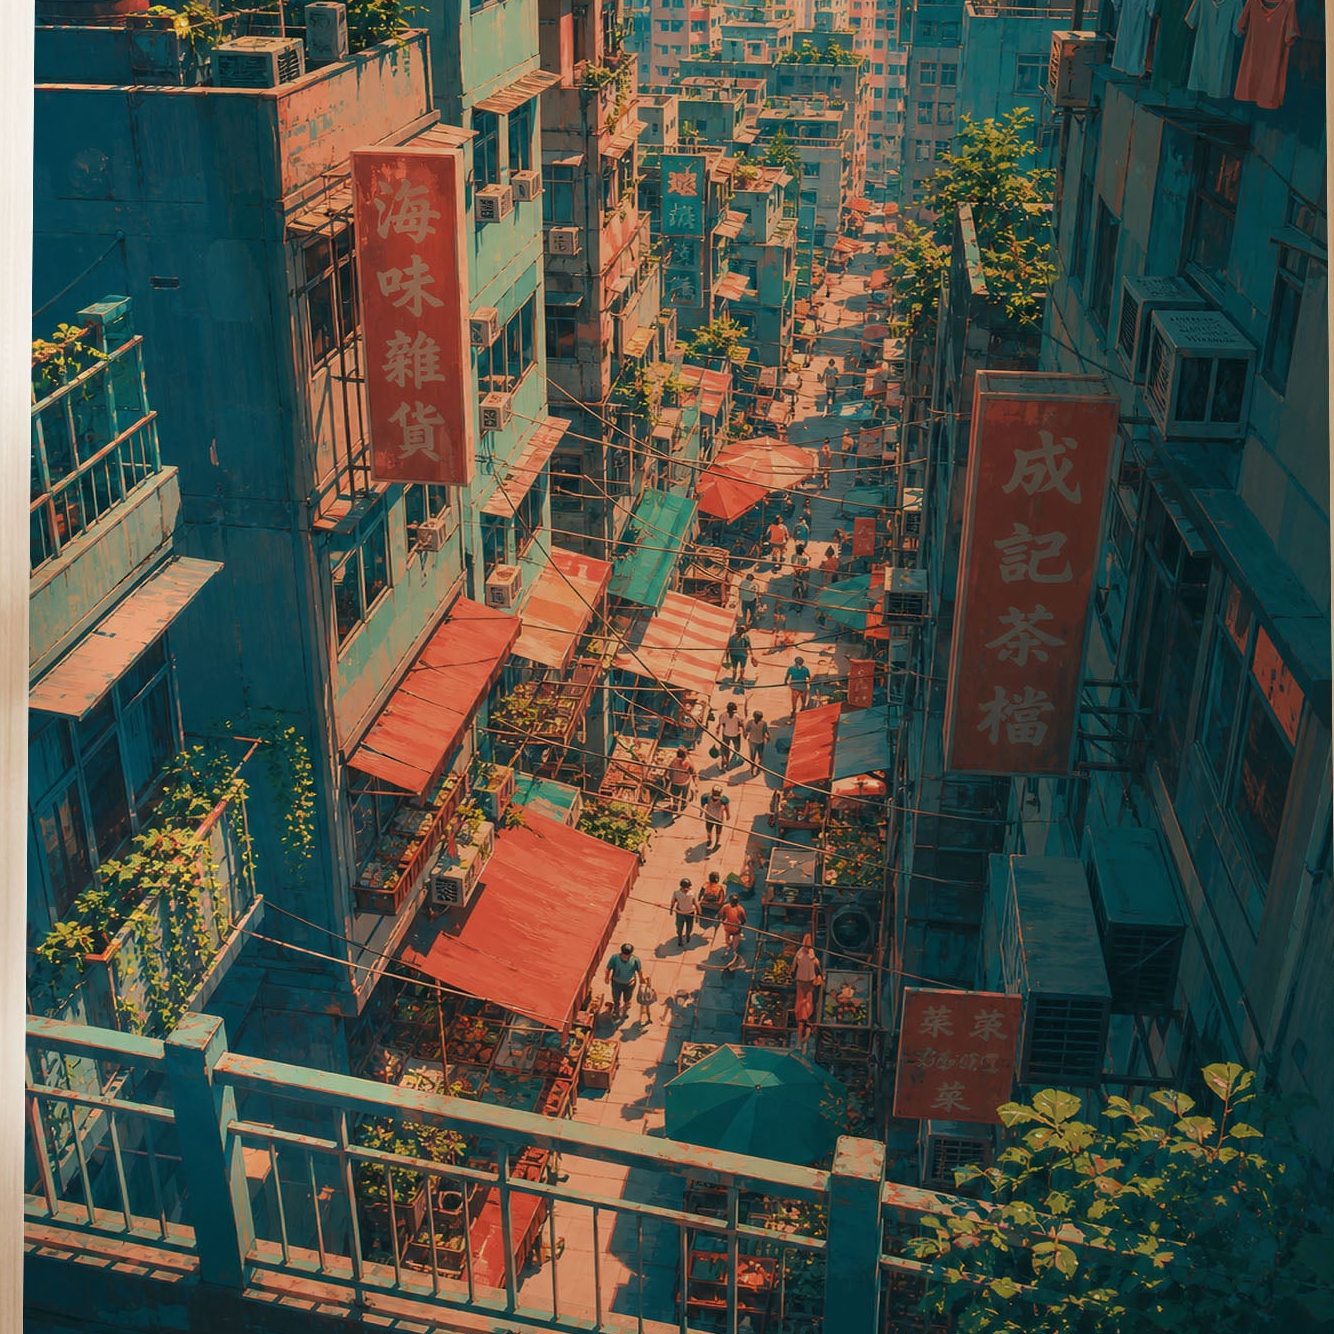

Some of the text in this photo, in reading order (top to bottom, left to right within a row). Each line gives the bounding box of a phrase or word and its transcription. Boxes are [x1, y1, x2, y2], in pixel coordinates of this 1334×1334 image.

[375, 180, 446, 463] 海味雜貨
[977, 430, 1083, 748] 成記茶檔
